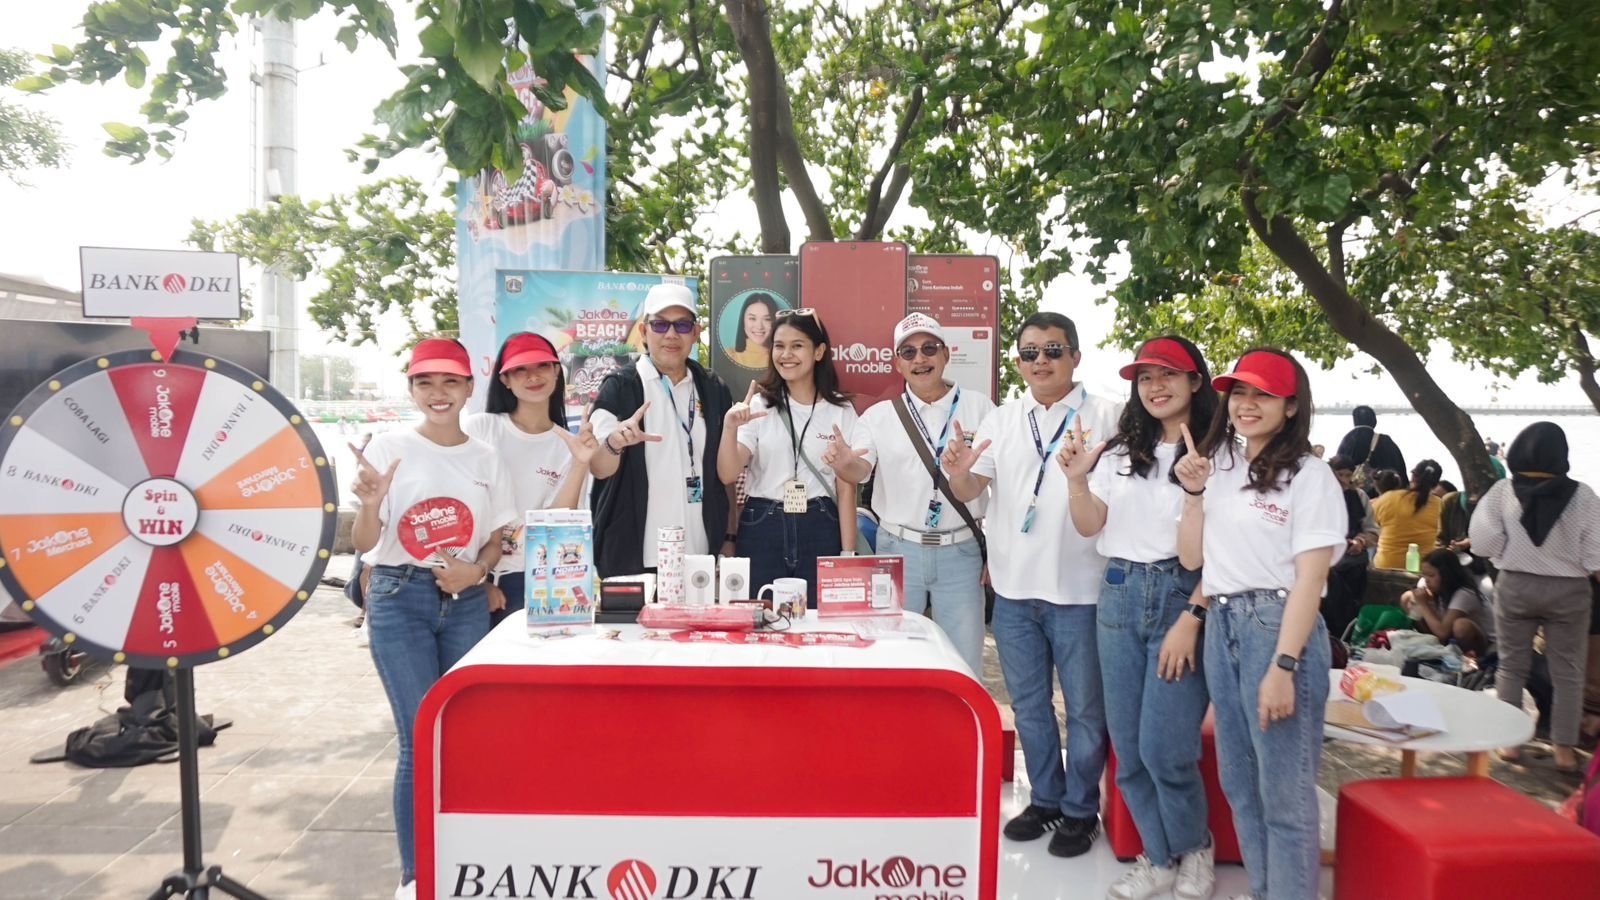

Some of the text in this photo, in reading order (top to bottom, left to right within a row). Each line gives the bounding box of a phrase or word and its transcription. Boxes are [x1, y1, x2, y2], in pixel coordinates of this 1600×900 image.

[89, 273, 232, 292] BANK DKI
[638, 283, 653, 291] DK
[577, 308, 628, 320] JakOne
[576, 323, 626, 337] BEACH
[830, 343, 893, 361] akOne
[846, 362, 893, 373] mobile
[63, 397, 110, 444] COBA LAGI
[156, 385, 174, 438] JakOne
[222, 403, 247, 433] BANK
[149, 407, 160, 438] mobile
[202, 440, 220, 461] DKI
[6, 465, 100, 496] 8 BANK DKI
[242, 468, 296, 497] JakOne
[144, 489, 178, 503] Spin
[409, 505, 456, 525] JakOne
[430, 514, 457, 527] mobile
[139, 519, 183, 535] WIN
[228, 523, 251, 537] DKI
[11, 527, 89, 560] 7 JakOne
[262, 534, 297, 552] BANK
[81, 583, 109, 613] BANK
[112, 556, 131, 577] DKI
[205, 566, 246, 613] JakOne
[156, 582, 177, 648] 5 JakOne
[449, 863, 763, 900] BANK DKI
[808, 856, 967, 888] JakOne
